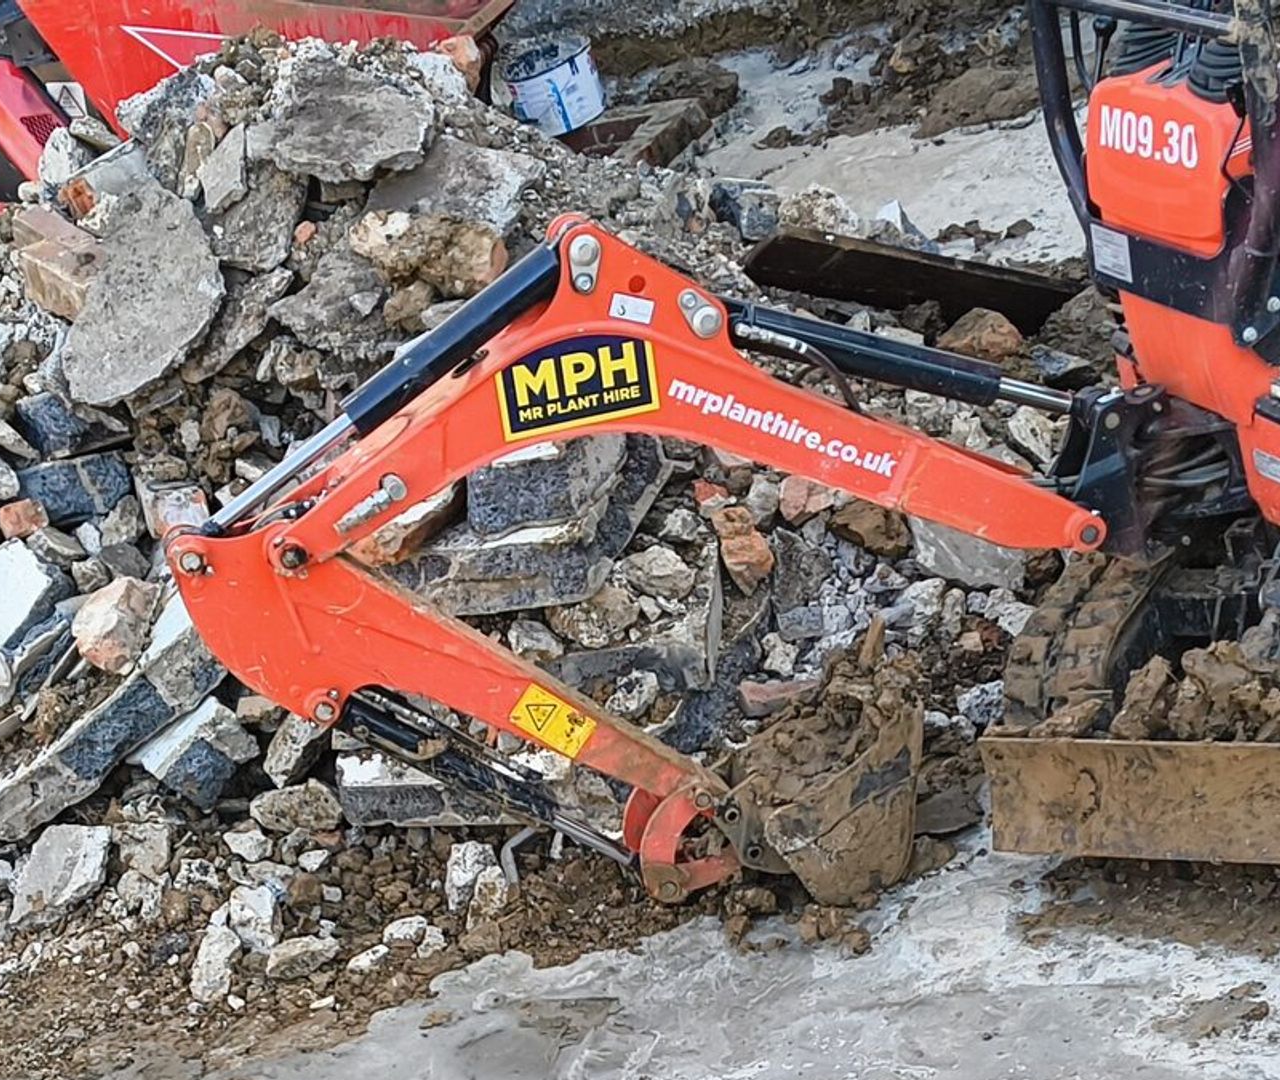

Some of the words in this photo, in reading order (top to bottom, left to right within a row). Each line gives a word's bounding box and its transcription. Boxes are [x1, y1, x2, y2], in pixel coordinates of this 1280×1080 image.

[1100, 104, 1198, 169] M09.30
[512, 341, 639, 407] MPH
[519, 406, 544, 423] MR
[546, 394, 600, 416] PLANT
[603, 385, 641, 405] HIRE
[668, 378, 898, 478] mrplanthire.co.uk
